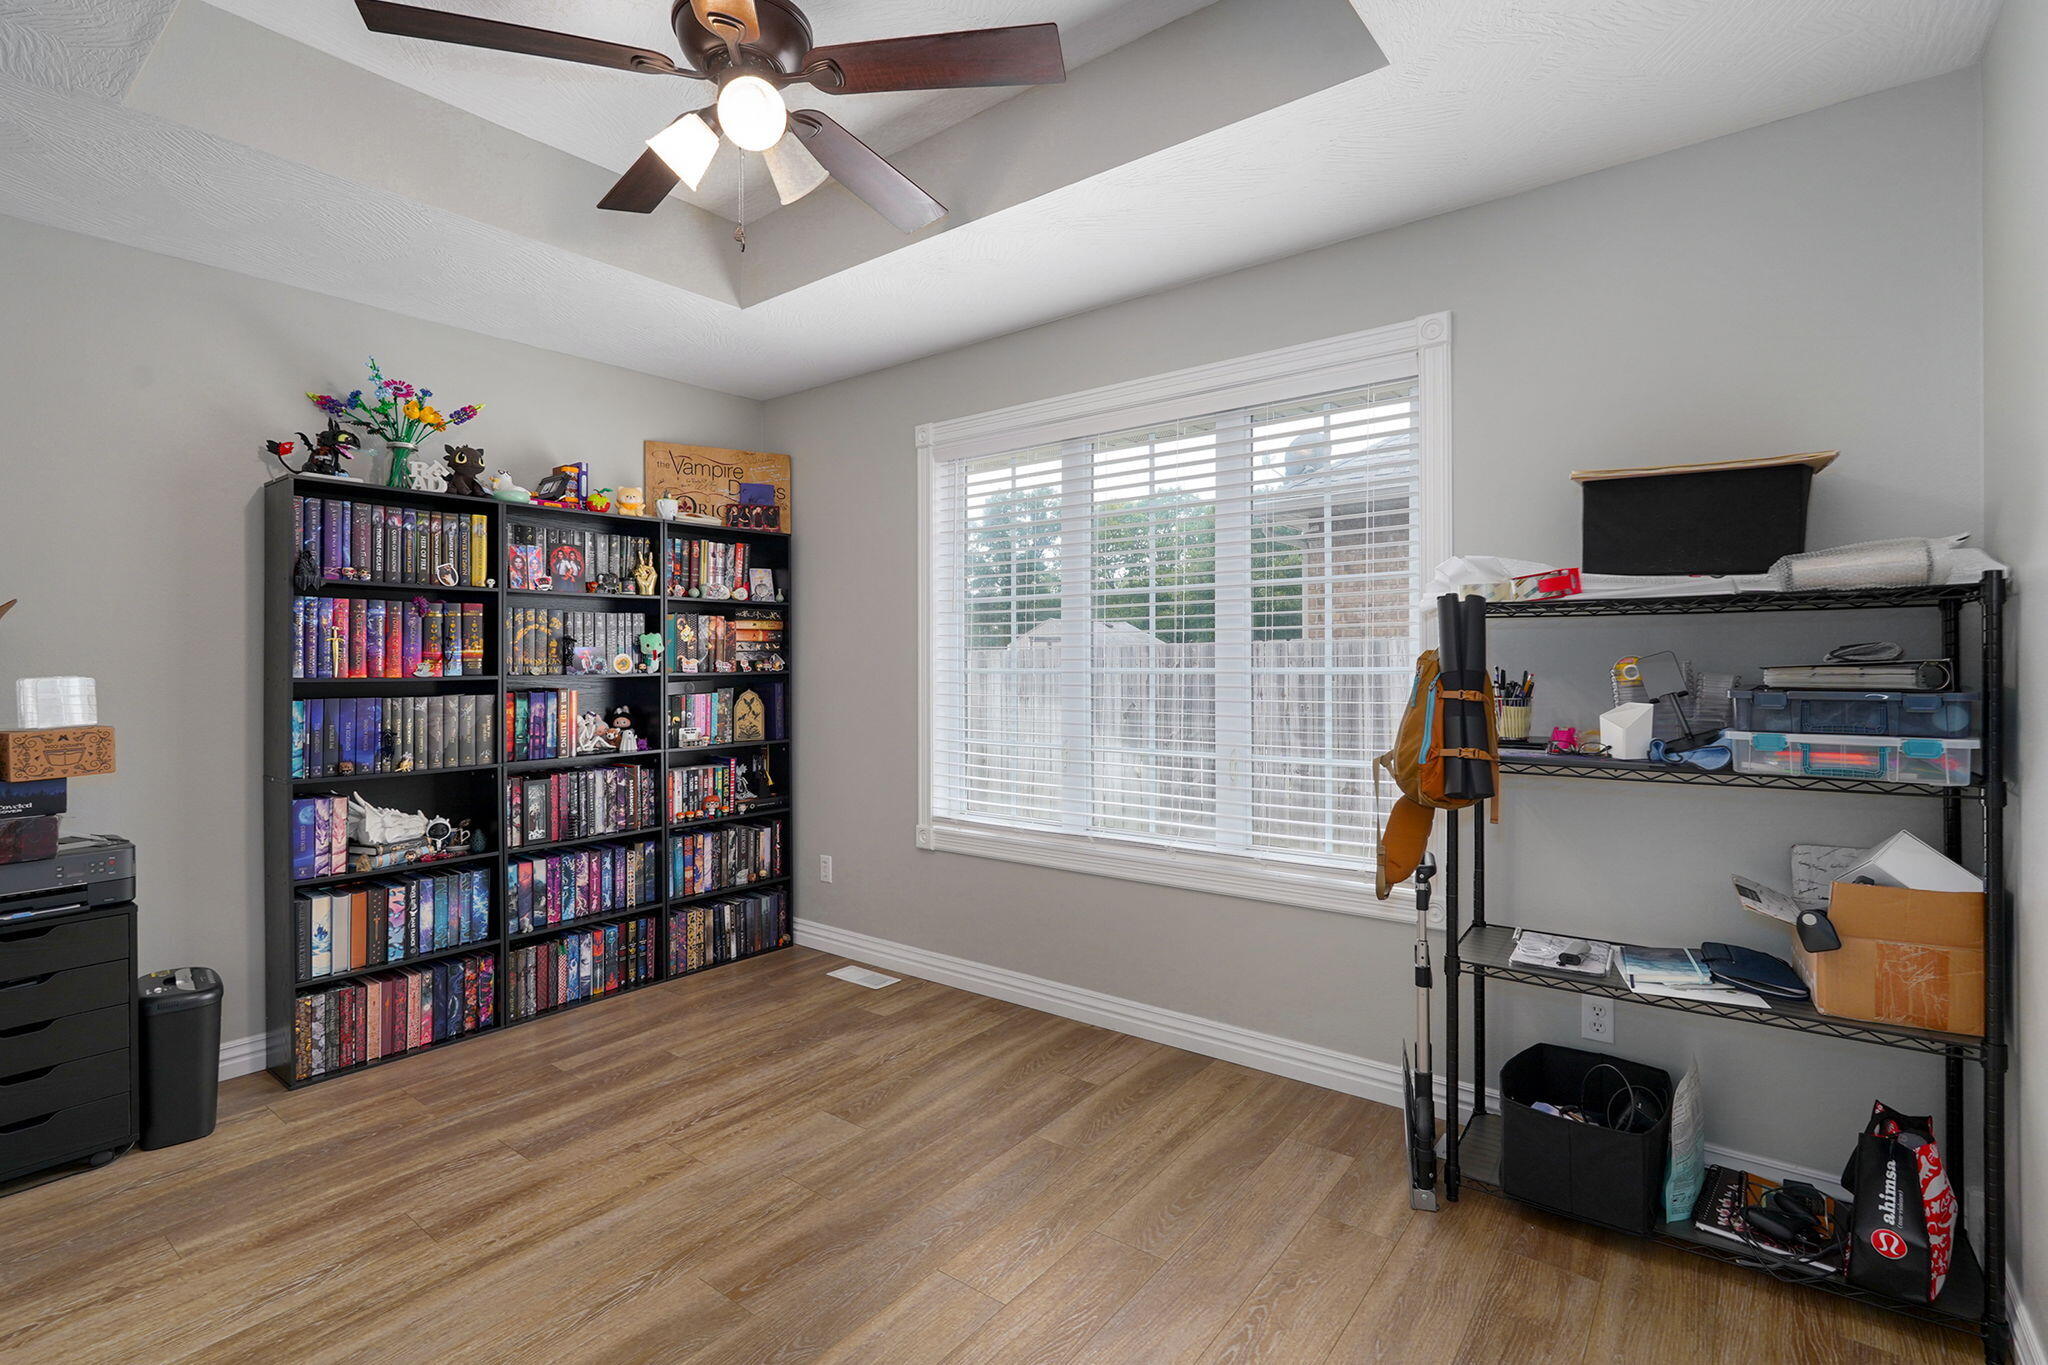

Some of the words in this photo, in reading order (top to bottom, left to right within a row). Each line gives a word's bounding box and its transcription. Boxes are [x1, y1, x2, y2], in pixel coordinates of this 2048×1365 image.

[656, 460, 670, 470] the
[668, 450, 744, 481] Vampire
[1878, 1160, 1896, 1226] ahimsa
